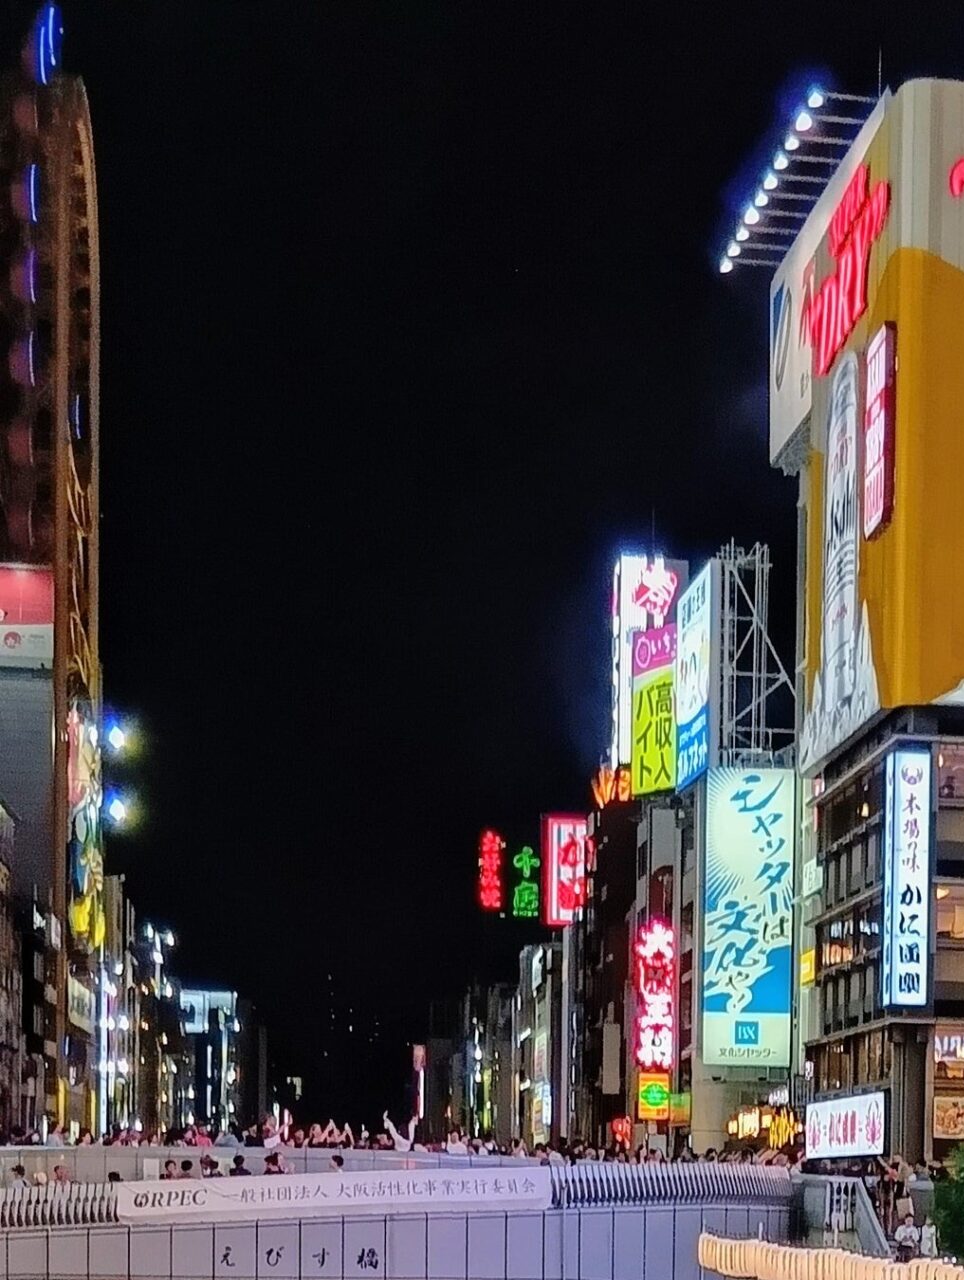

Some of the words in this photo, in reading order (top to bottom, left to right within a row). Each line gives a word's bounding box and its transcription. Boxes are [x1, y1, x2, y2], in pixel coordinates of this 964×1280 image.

[635, 683, 655, 788] バイト
[655, 681, 672, 784] 高収入
[221, 1186, 328, 1204] 一般社団法人
[219, 1245, 380, 1271] えびす橋
